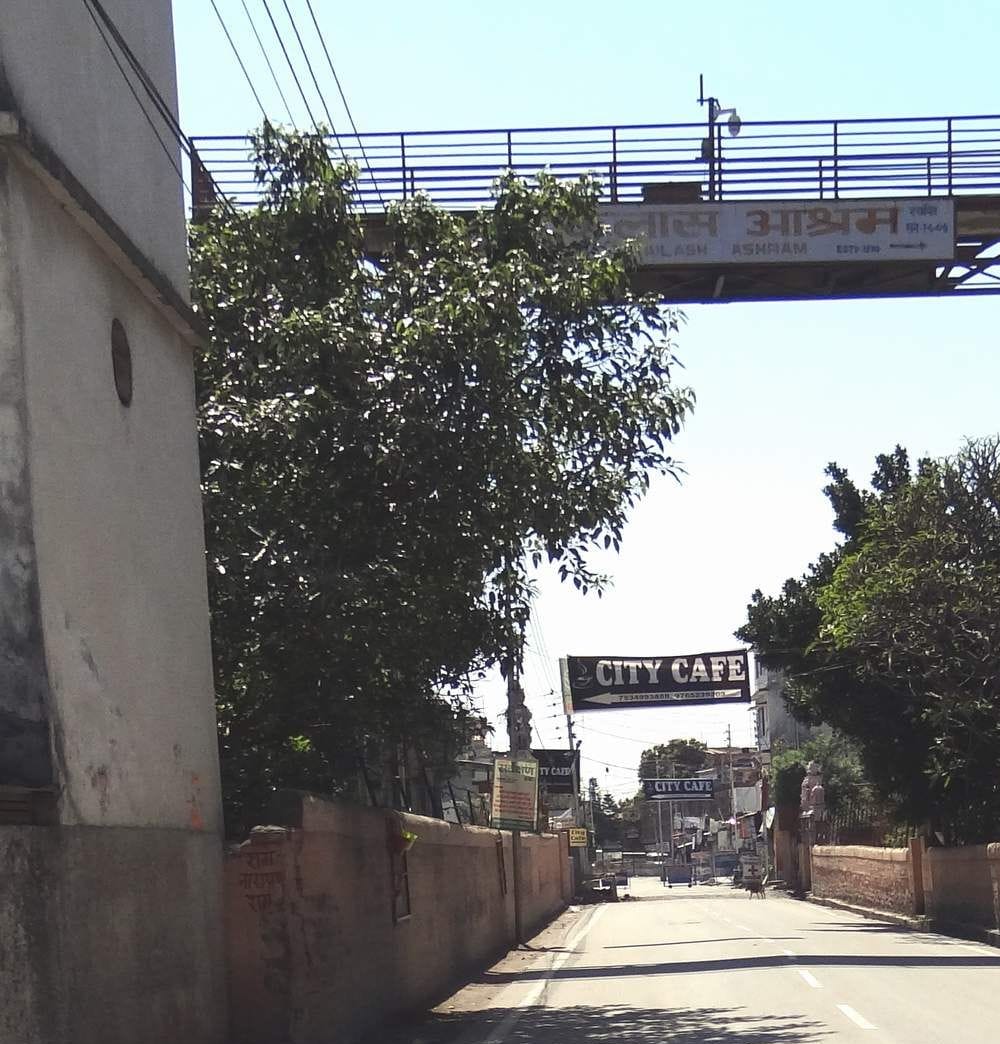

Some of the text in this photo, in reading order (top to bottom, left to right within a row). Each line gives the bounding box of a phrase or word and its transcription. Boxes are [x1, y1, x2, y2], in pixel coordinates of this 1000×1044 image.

[746, 206, 898, 237] आश्रम
[732, 242, 807, 255] ASHRAM
[596, 655, 746, 686] CITY CAFE
[654, 781, 713, 792] CITY CAFE
